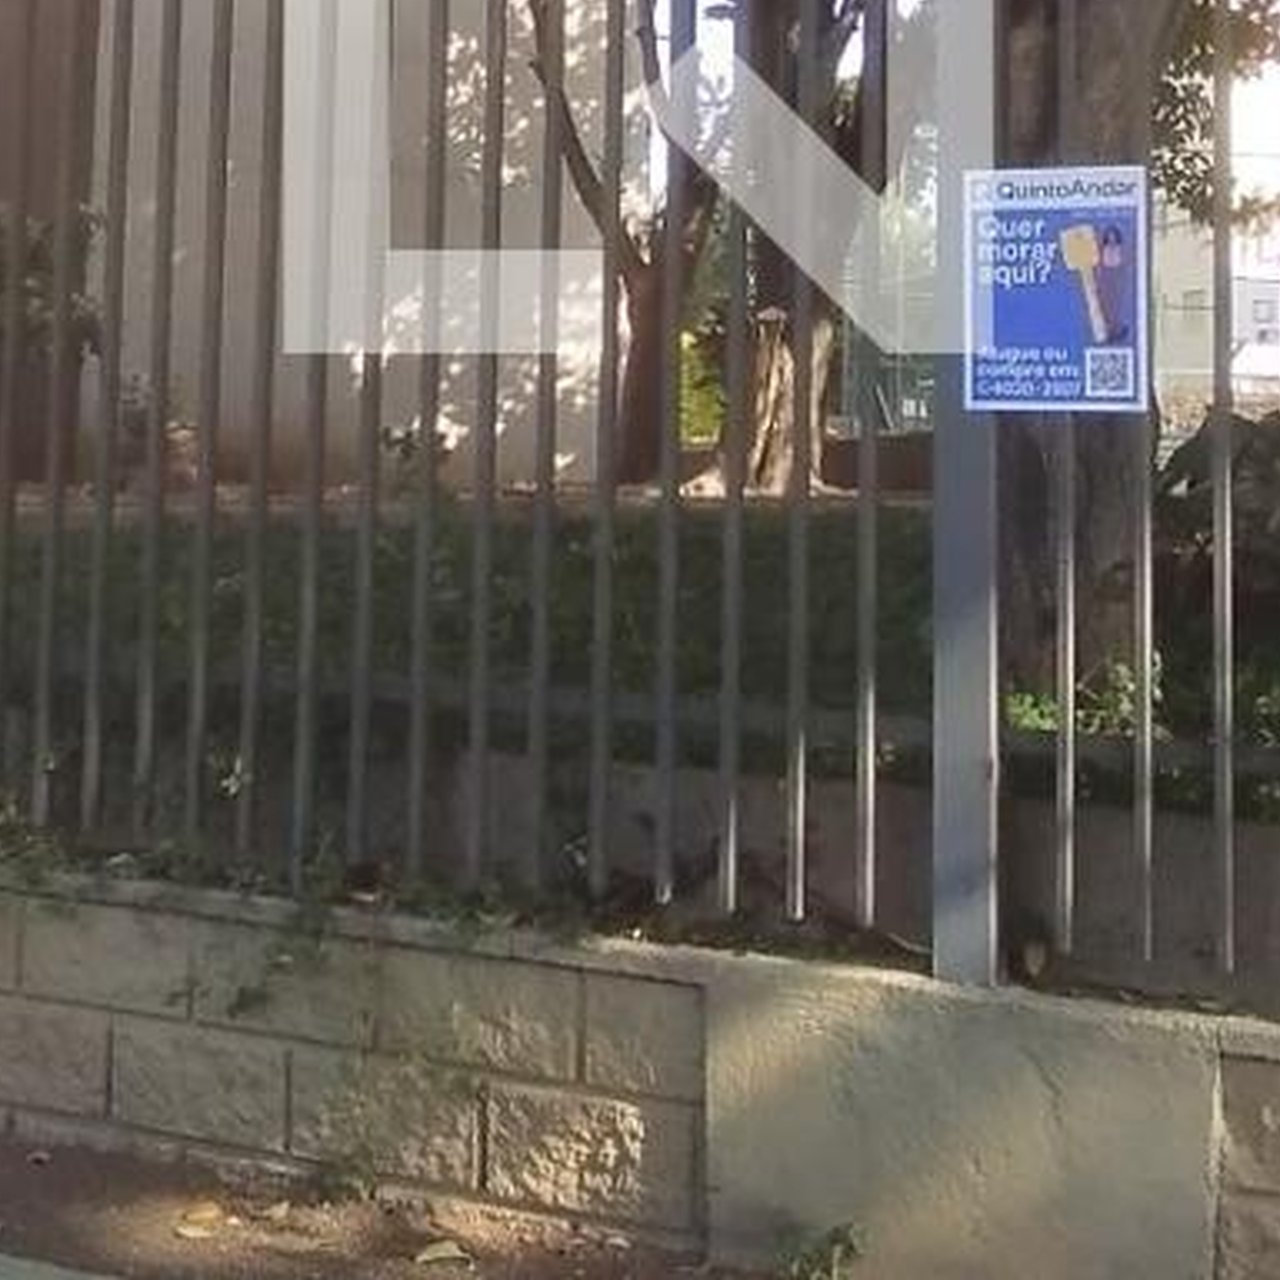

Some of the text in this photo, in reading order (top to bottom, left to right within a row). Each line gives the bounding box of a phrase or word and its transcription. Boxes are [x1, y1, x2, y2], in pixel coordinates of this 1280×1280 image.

[996, 179, 1138, 201] QuintoAndar
[977, 217, 1046, 241] Quer
[977, 241, 1058, 262] morar
[976, 262, 1052, 290] aqui?
